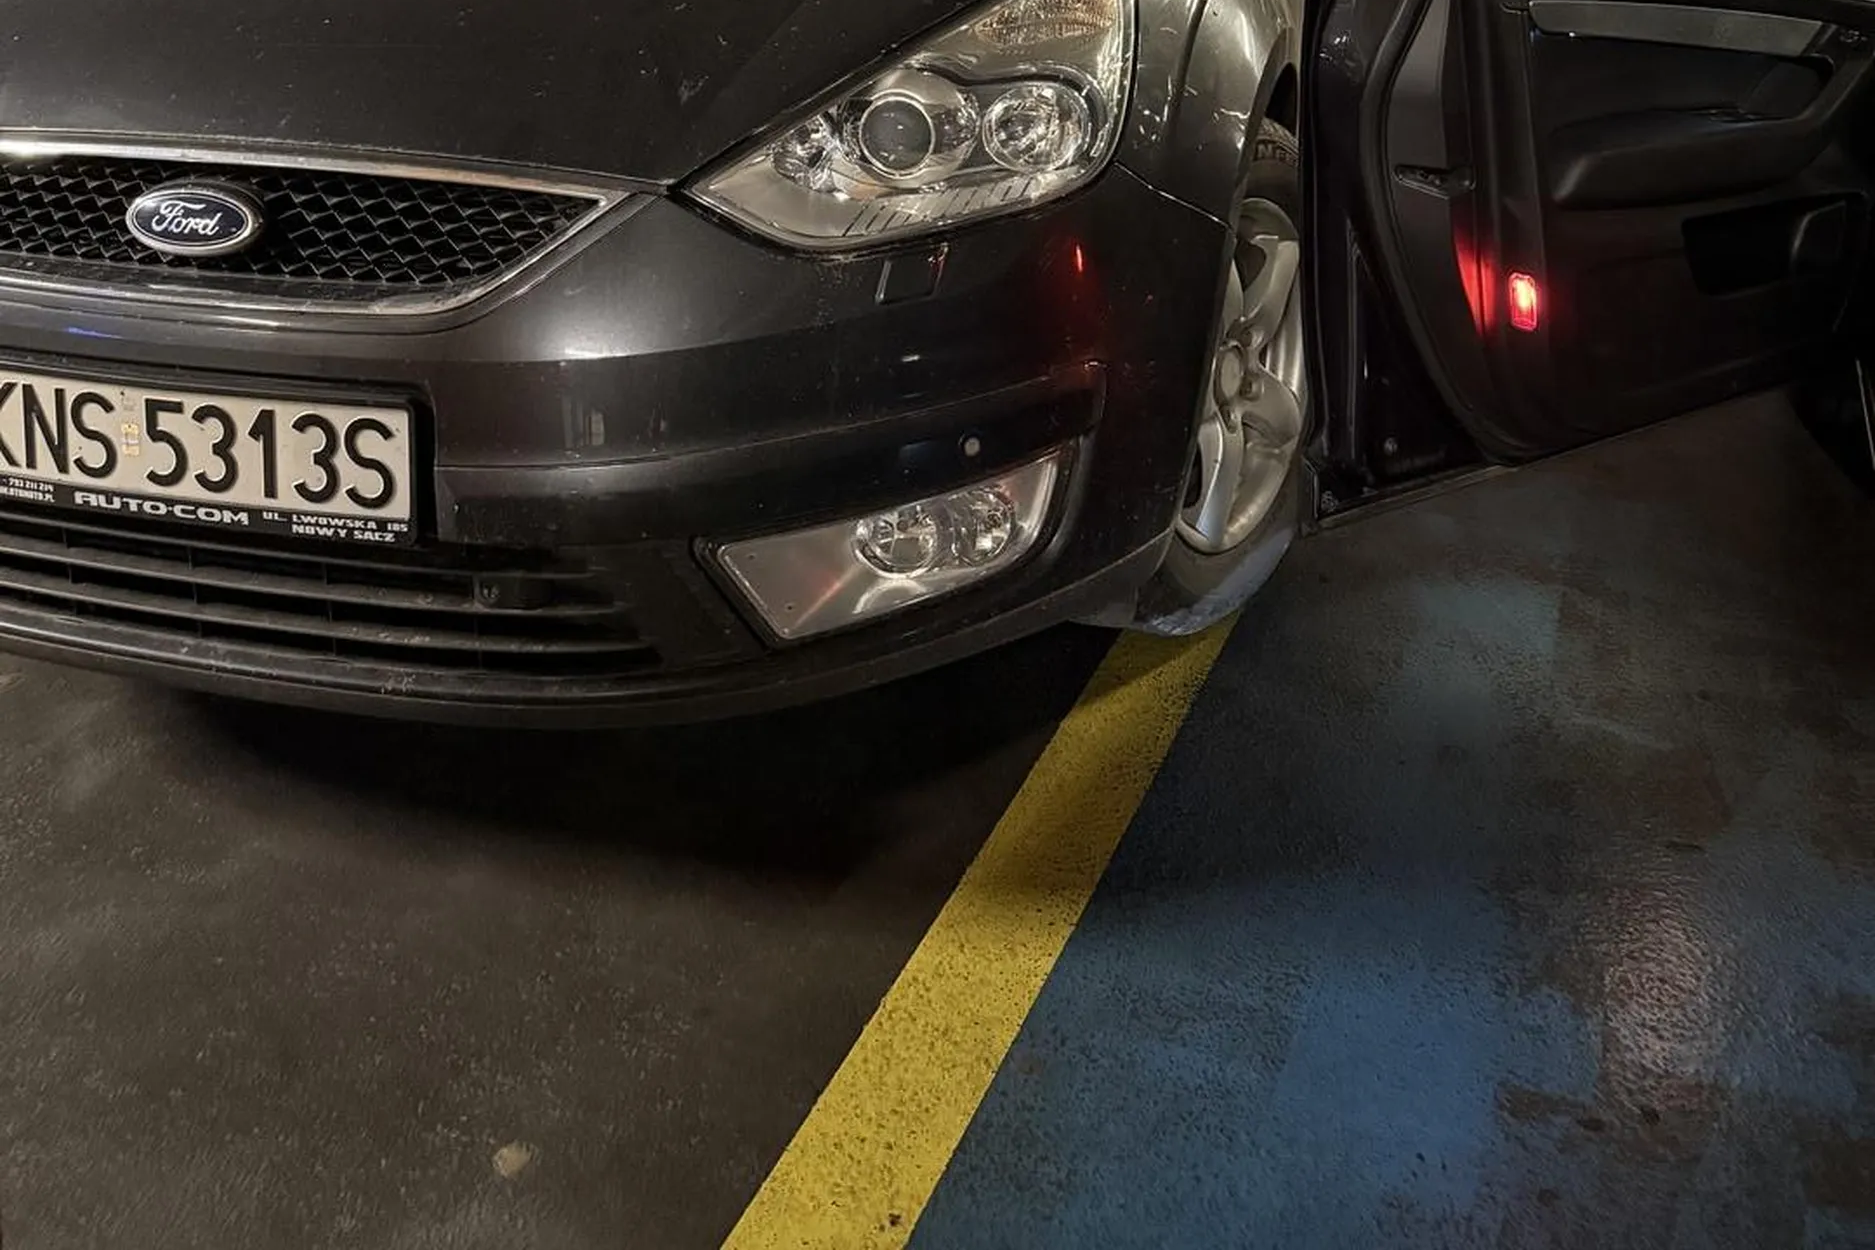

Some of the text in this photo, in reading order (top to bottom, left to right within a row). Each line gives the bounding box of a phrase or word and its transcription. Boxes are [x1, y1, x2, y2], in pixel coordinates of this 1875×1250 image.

[152, 200, 222, 236] Ford
[145, 398, 394, 509] 5313S
[292, 514, 377, 530] LWOWSKA
[292, 524, 347, 538] NOWY
